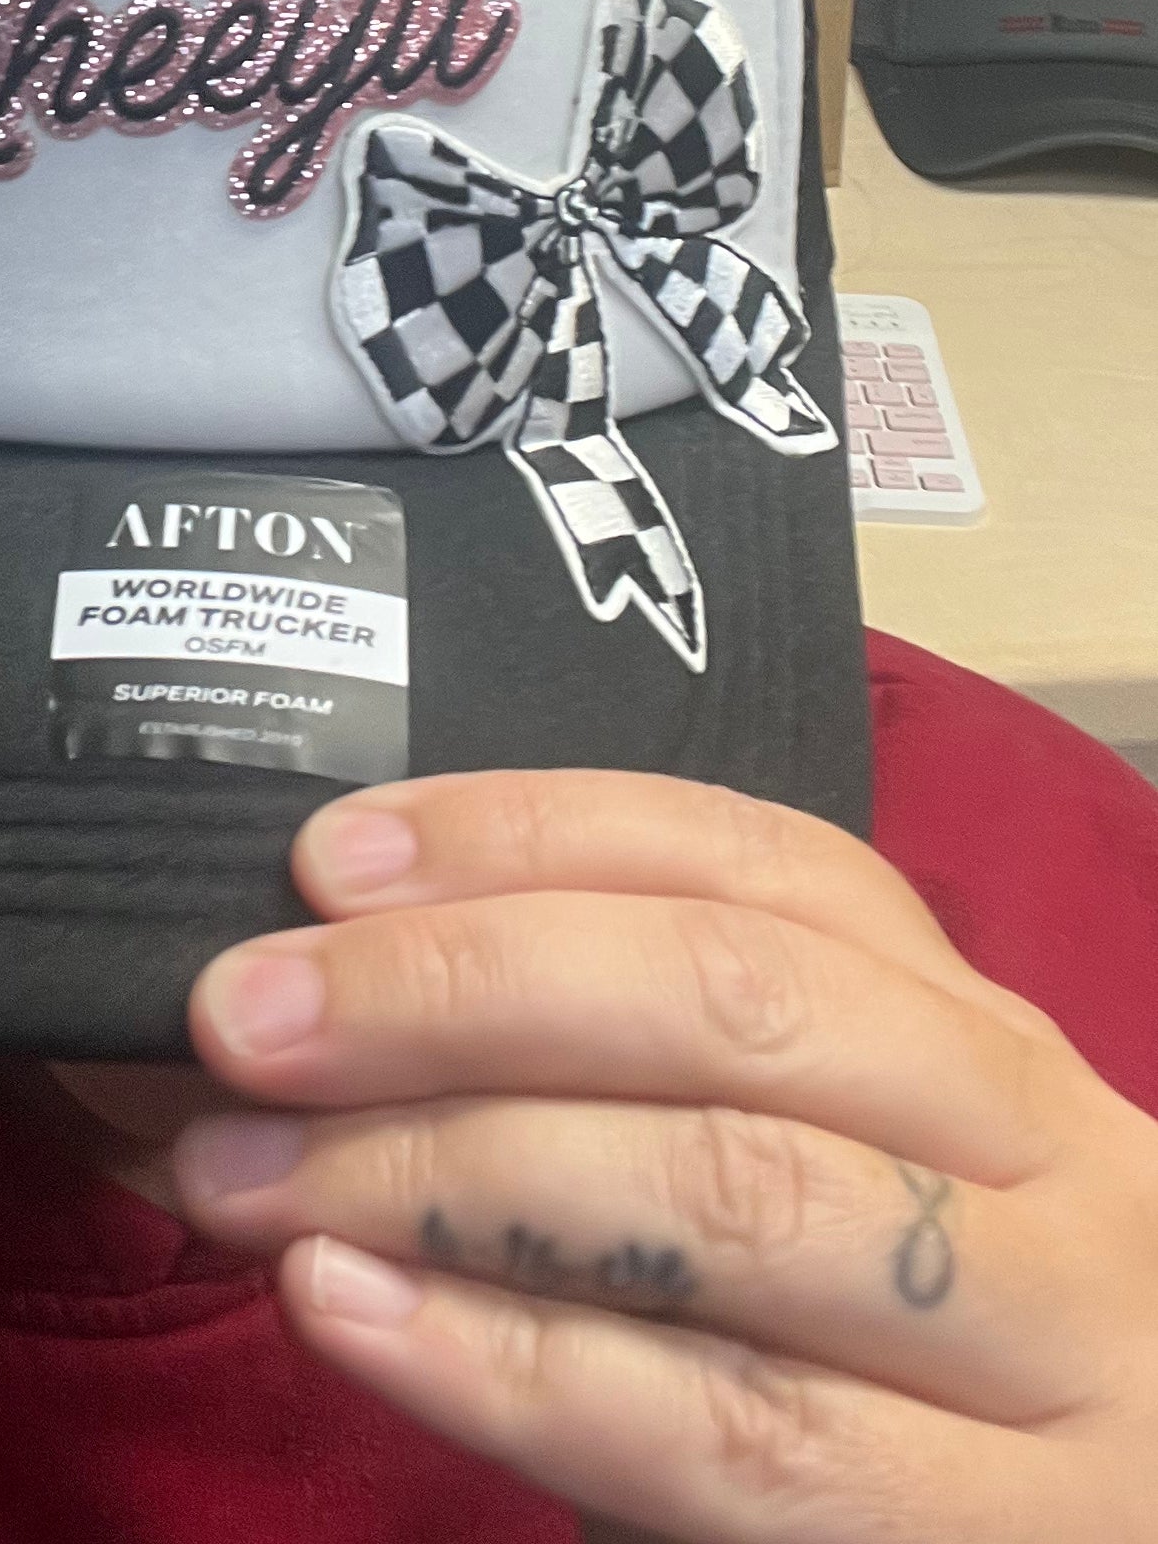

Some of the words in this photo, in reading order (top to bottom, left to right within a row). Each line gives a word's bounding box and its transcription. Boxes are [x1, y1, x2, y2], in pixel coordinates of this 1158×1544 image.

[106, 502, 368, 564] AFTON
[112, 578, 348, 616] WORLDWIDE
[77, 605, 187, 628] FOAM
[199, 607, 376, 649] TRUCKER
[184, 636, 267, 657] OSFM
[113, 683, 249, 706] SUPERIOR
[252, 690, 335, 715] FOAM
